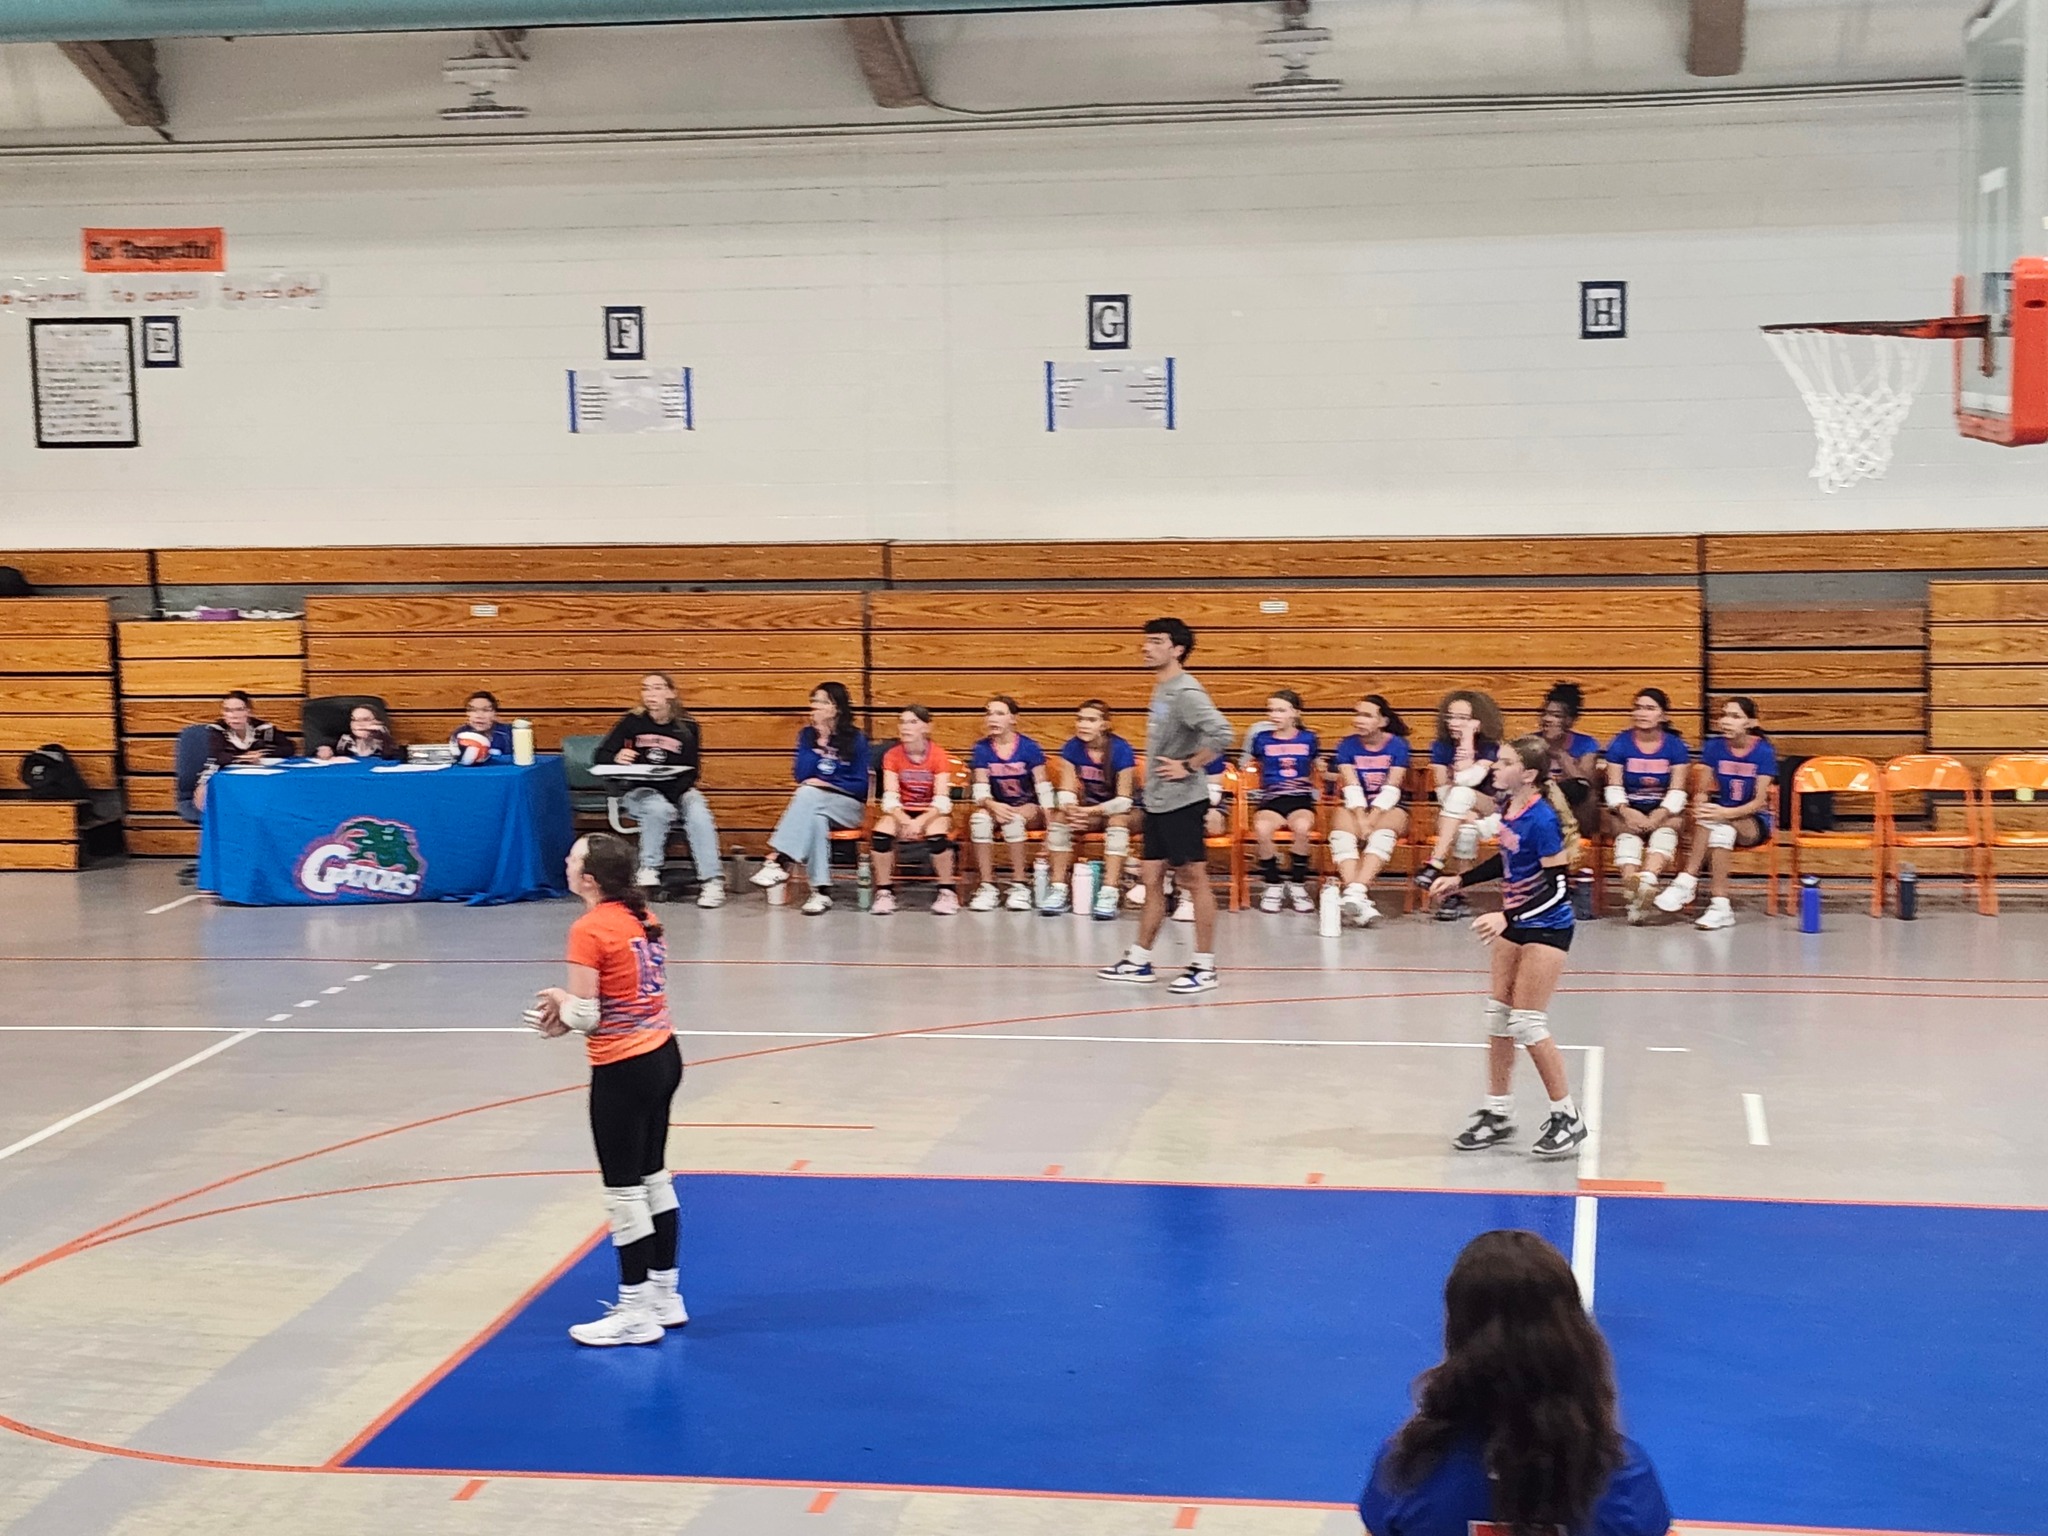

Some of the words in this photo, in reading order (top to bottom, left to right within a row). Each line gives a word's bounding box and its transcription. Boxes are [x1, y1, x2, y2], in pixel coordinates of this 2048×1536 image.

[1094, 304, 1125, 338] G
[1587, 296, 1620, 327] H
[147, 327, 173, 354] E
[610, 316, 640, 349] F
